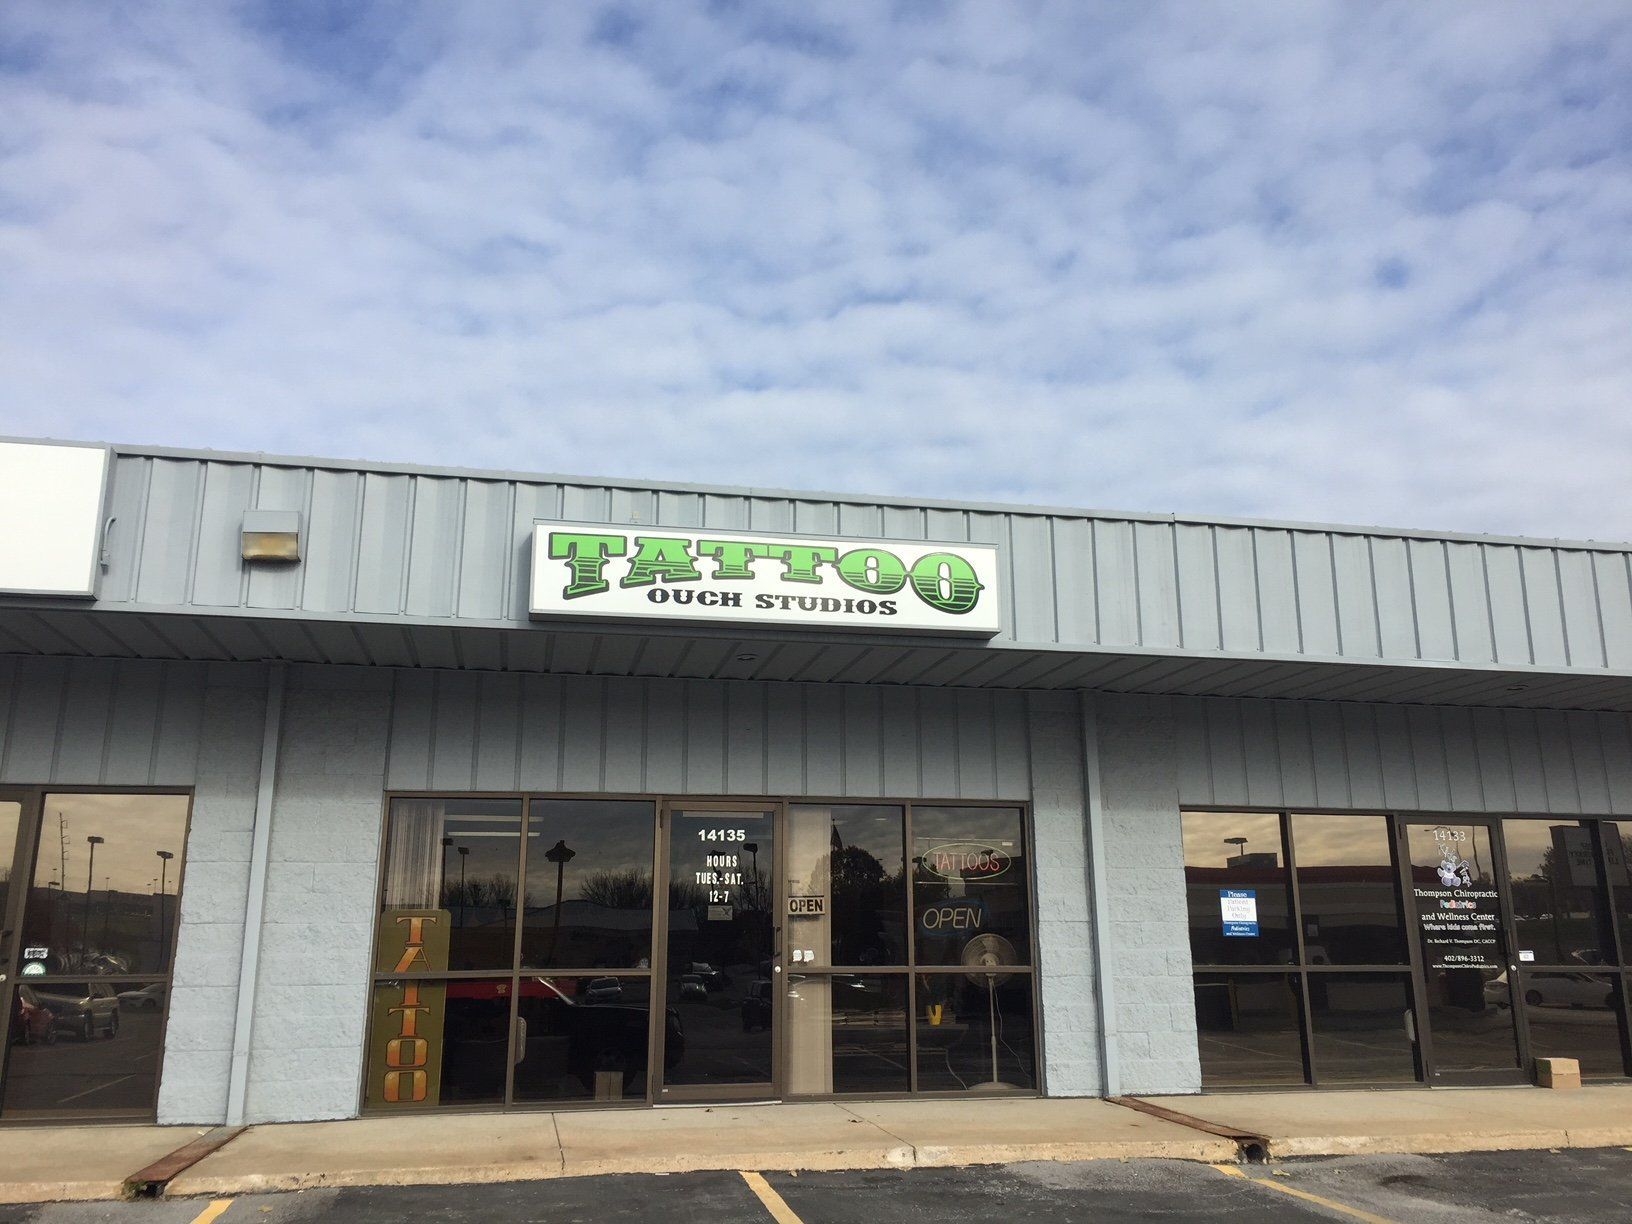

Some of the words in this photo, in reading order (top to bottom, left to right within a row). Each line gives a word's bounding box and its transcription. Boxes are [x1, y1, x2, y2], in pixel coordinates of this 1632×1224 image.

[548, 531, 985, 615] TATTOO
[646, 587, 742, 608] OUCH
[755, 593, 898, 616] STUDIOS
[698, 829, 746, 842] 14135
[1433, 830, 1466, 842] 14133
[706, 855, 738, 868] HOURS
[932, 851, 1000, 871] TATTOOS
[709, 891, 729, 903] 12-7
[1413, 888, 1452, 898] Thompson
[1453, 889, 1498, 899] Chiropractic
[789, 899, 824, 913] OPEN
[923, 907, 982, 929] OPEN
[1421, 912, 1436, 921] and
[1436, 912, 1470, 921] Wellness
[1470, 912, 1495, 921] Center
